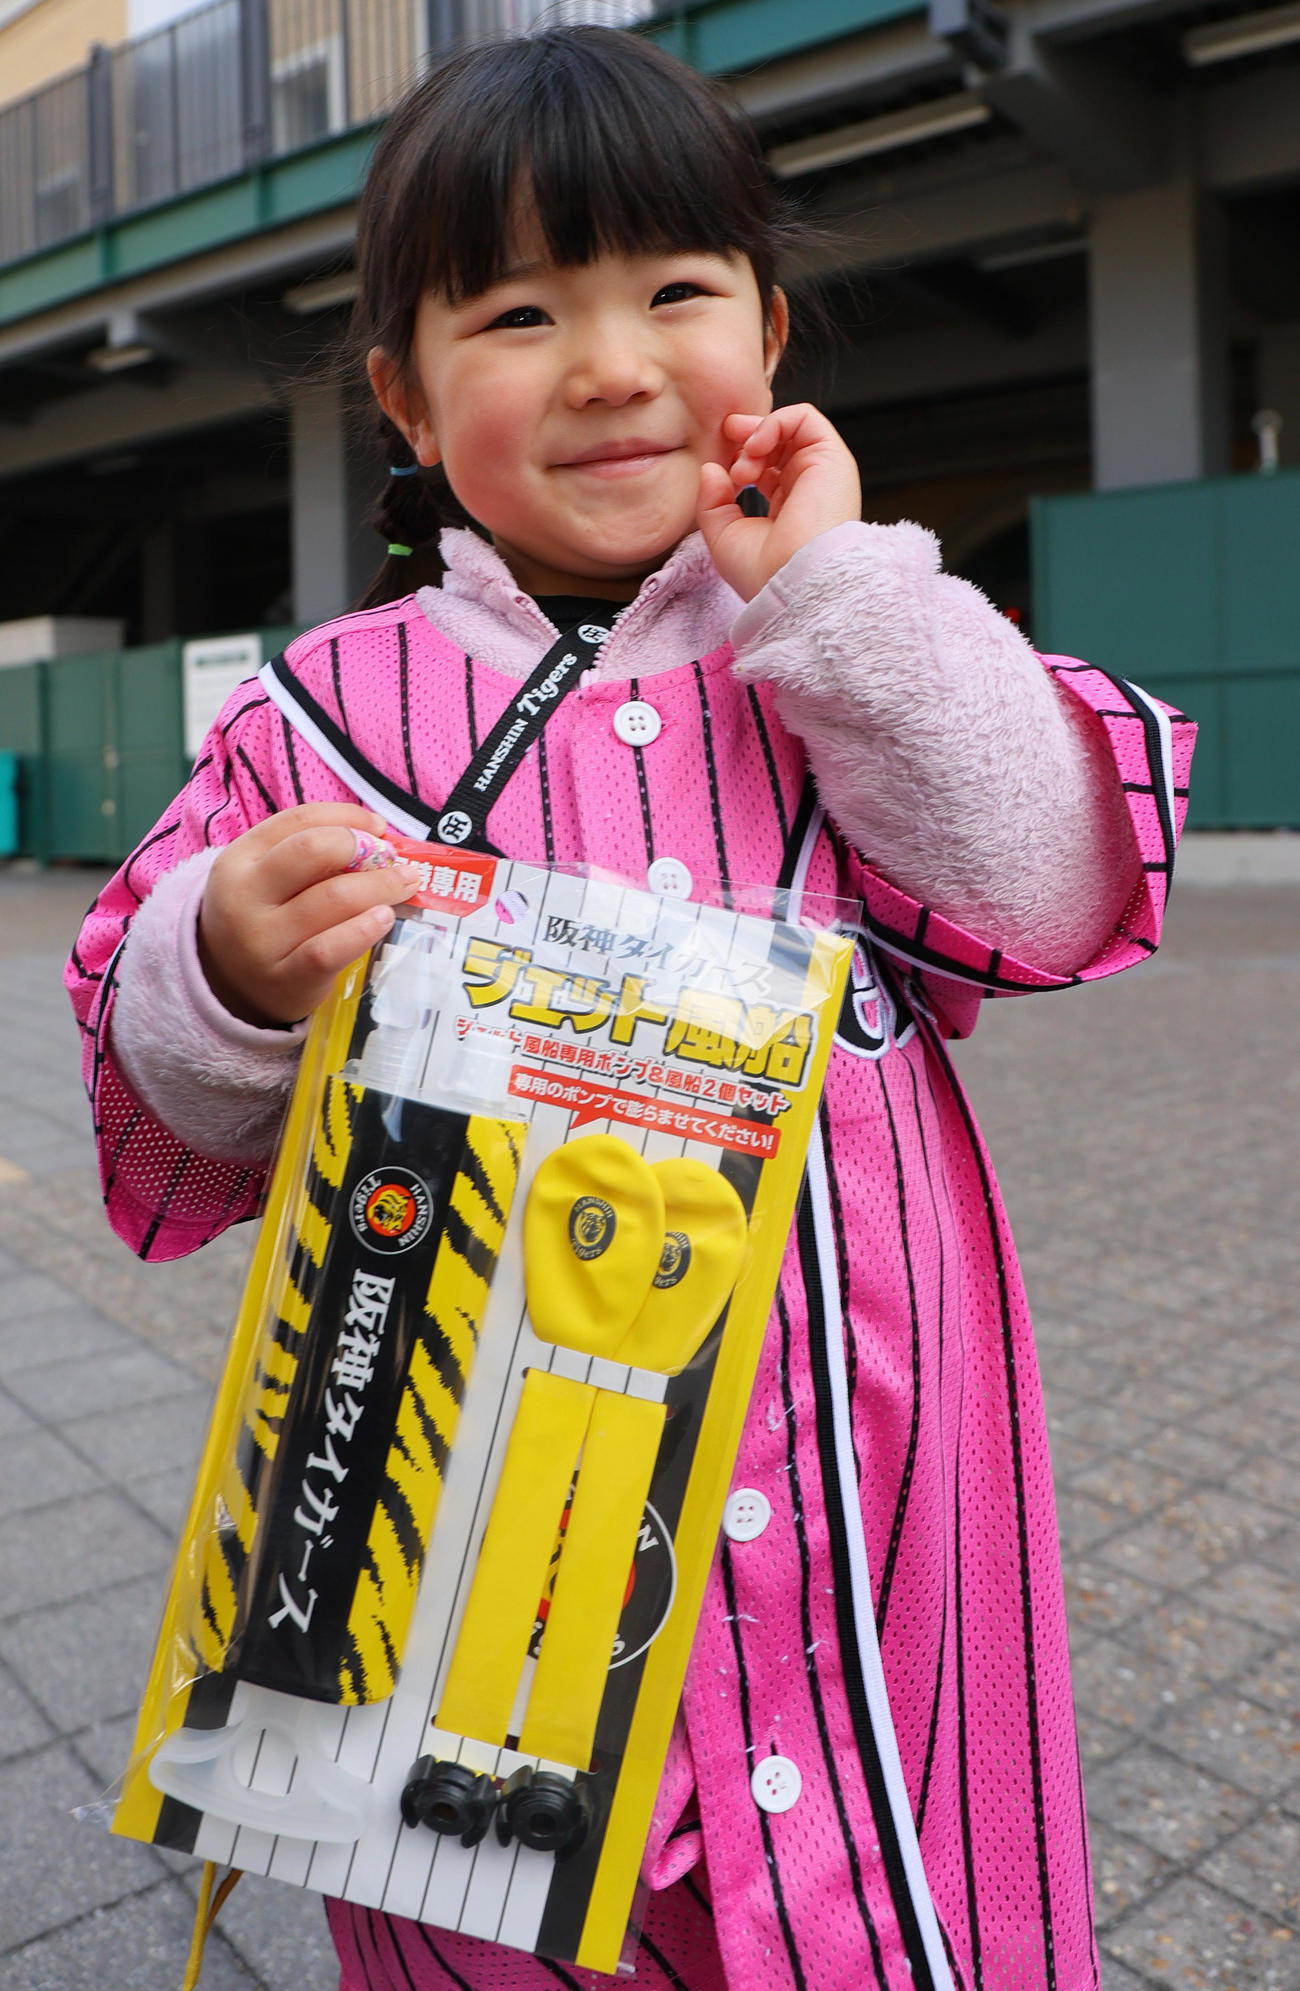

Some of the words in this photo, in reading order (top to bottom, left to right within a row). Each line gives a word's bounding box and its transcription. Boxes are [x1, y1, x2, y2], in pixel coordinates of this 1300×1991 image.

[473, 718, 529, 792] HANSHIN
[516, 652, 578, 717] Tigers
[394, 856, 483, 904] 時専用
[542, 914, 773, 994] 阪神タイガース
[462, 936, 813, 1087] ジェット風船
[456, 1017, 791, 1115] ジト風船専用ポンプ&風船2個セット
[397, 1183, 429, 1247] HANSHIN
[267, 1268, 396, 1633] 阪神タイガース
